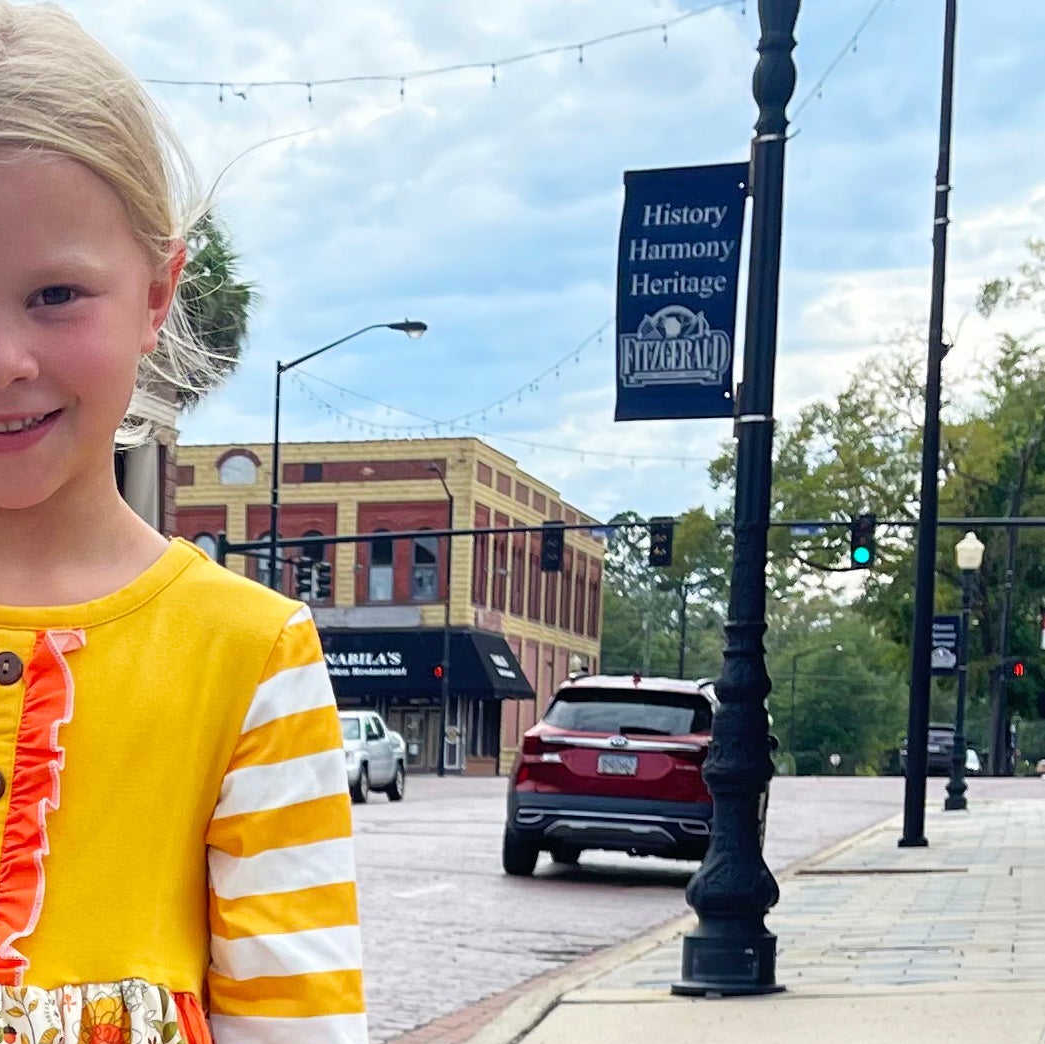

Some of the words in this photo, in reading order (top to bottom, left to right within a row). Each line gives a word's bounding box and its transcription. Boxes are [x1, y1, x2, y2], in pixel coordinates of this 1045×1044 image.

[642, 203, 727, 228] History
[629, 238, 735, 262] Harmony
[630, 271, 727, 298] Heritage
[623, 335, 728, 374] FITZGERALD
[324, 651, 402, 666] NABILA'S
